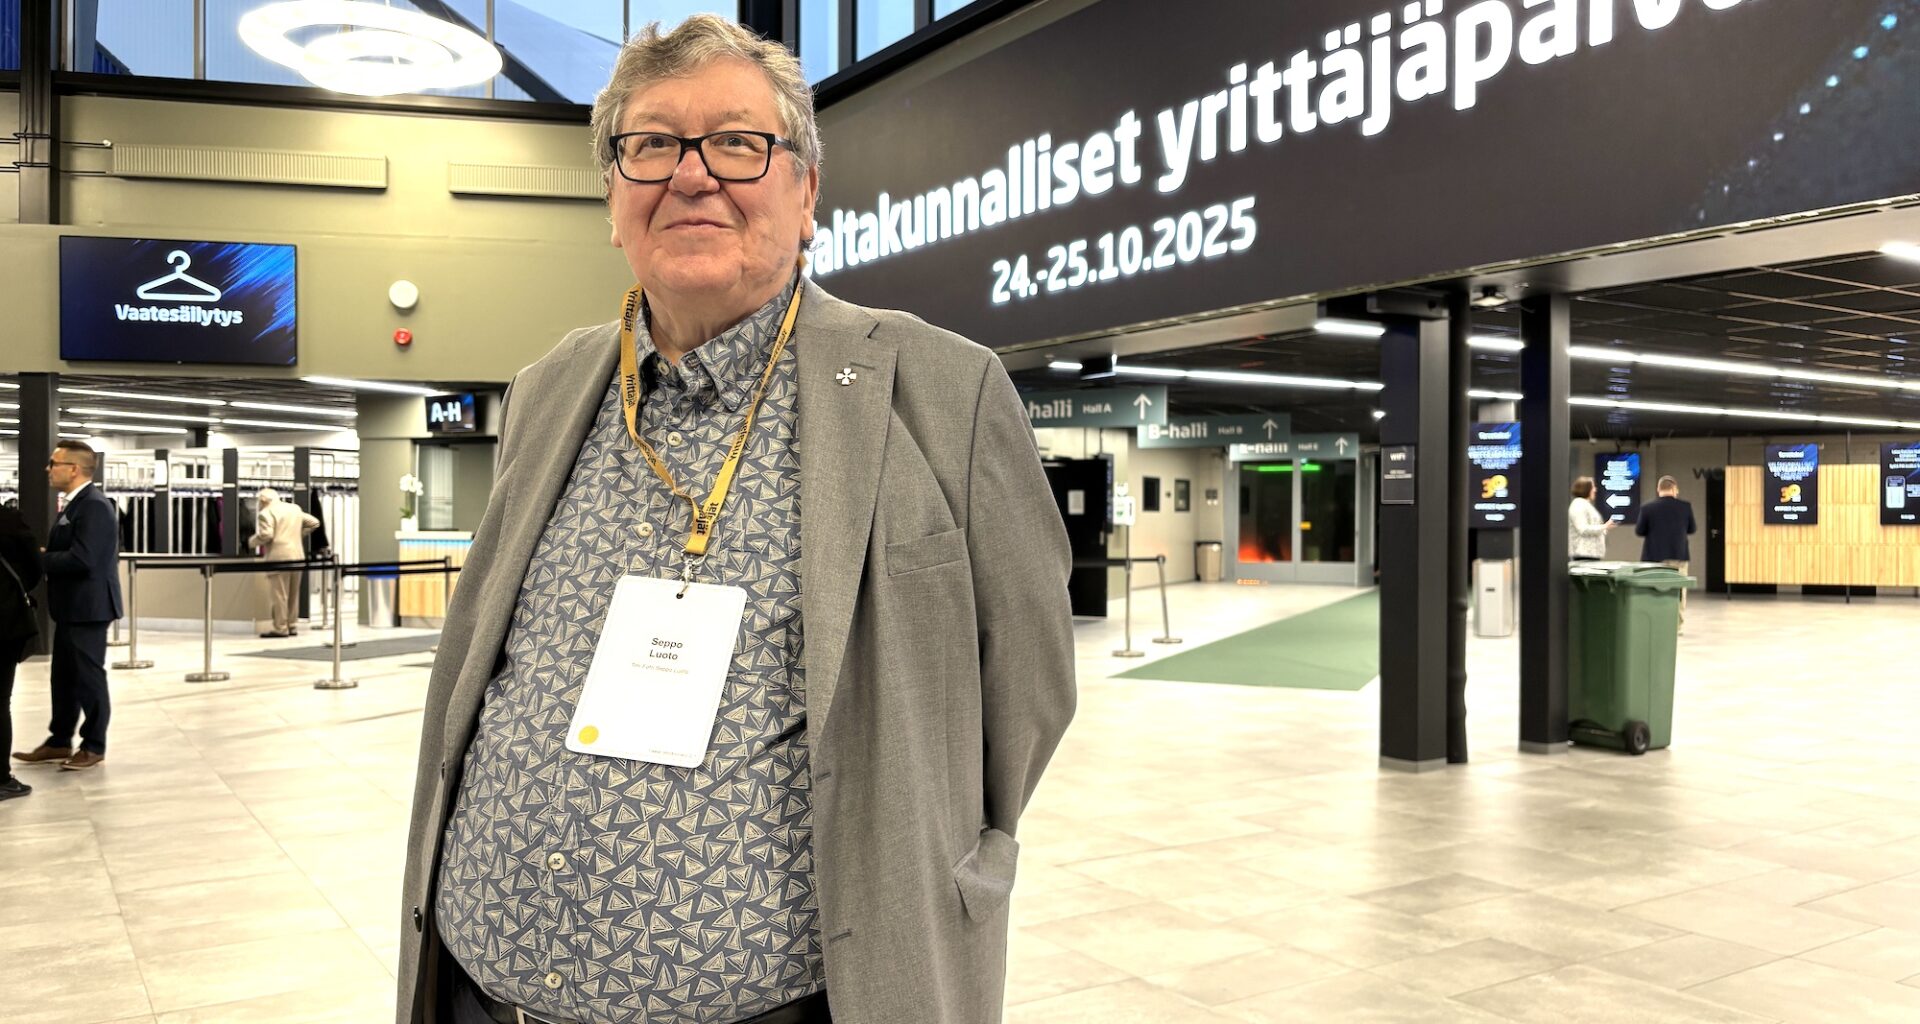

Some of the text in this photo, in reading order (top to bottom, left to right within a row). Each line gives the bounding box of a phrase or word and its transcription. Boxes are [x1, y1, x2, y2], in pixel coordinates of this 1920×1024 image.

[991, 196, 1257, 305] 24.-25.10.2025
[115, 303, 243, 327] Vaatesäilytys
[623, 290, 639, 333] Yrittäjät
[430, 401, 462, 423] A-H
[1028, 399, 1112, 419] halli Hall A
[1148, 422, 1207, 439] B-halli
[651, 637, 683, 649] Seppo
[649, 649, 678, 660] Luoto
